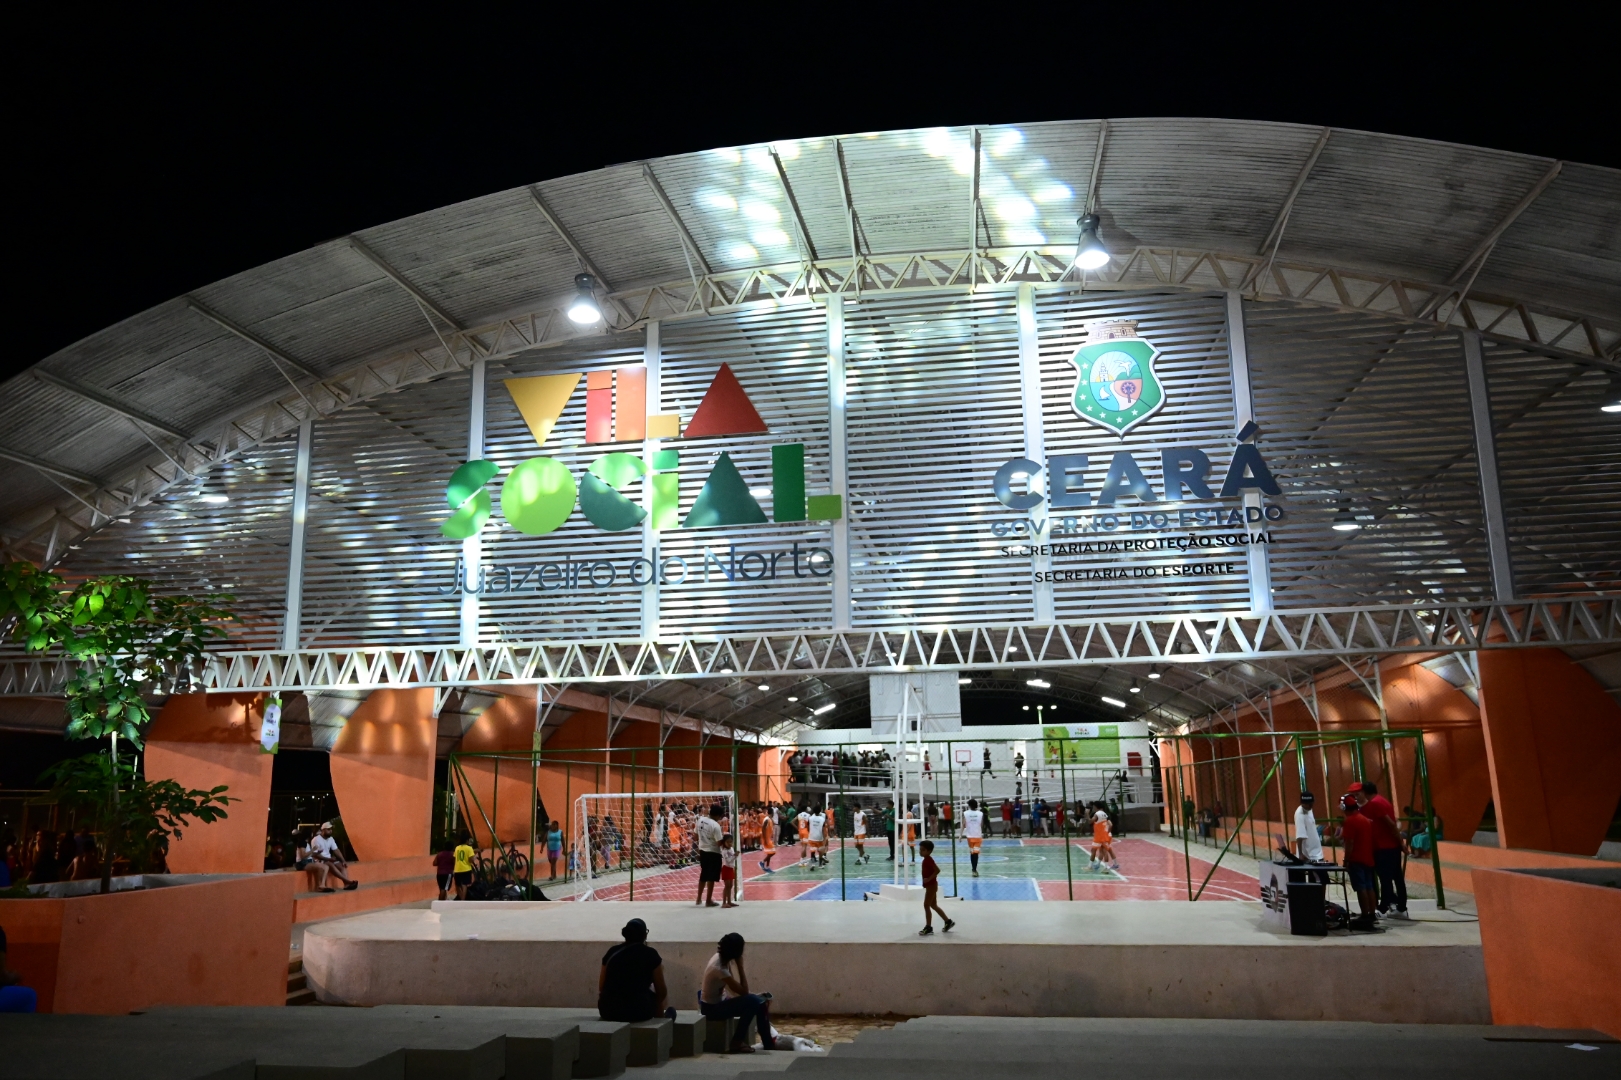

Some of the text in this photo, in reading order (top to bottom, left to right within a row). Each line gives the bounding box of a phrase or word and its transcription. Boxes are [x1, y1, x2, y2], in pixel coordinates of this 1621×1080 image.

[992, 420, 1283, 510] CEARÁ
[990, 504, 1285, 538] GOVERNO DO ESTADO
[1001, 531, 1276, 558] SECRETARIA DA PROTEÇÃO SOCIAL
[437, 541, 834, 596] Juazeiro do Norte
[1034, 562, 1235, 583] SECRETARIA DO ESPORTE
[457, 849, 465, 861] 10
